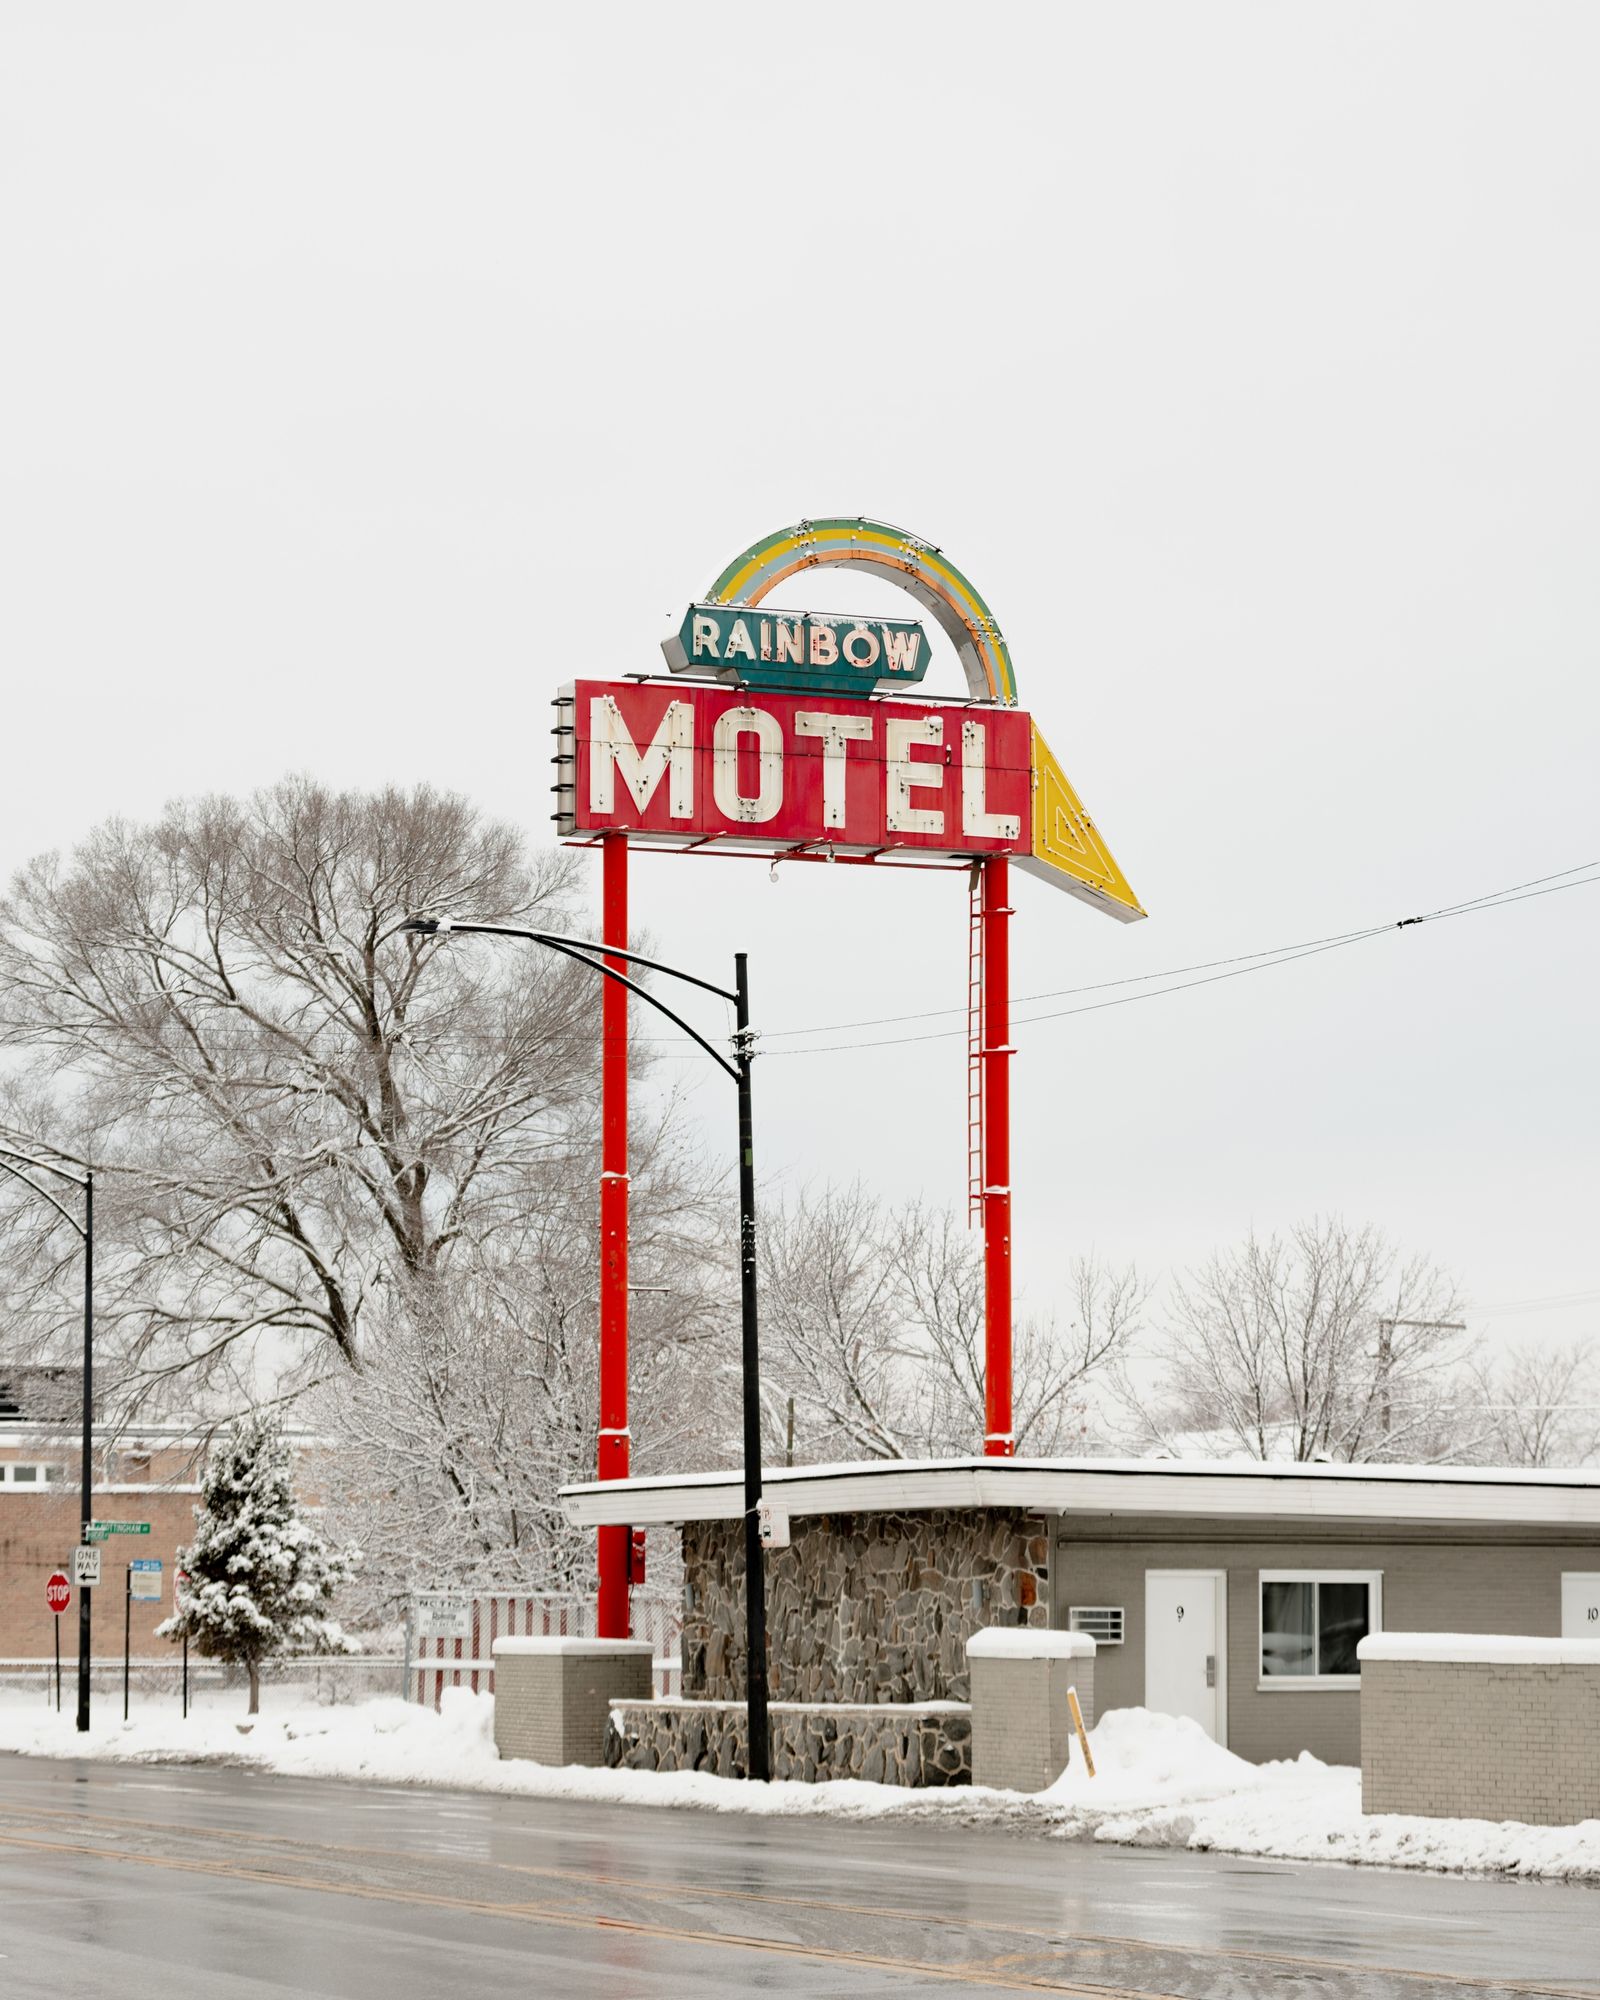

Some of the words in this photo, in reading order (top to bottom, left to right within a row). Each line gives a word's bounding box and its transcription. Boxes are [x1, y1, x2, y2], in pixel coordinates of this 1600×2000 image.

[692, 615, 921, 671] RAINBOW
[589, 694, 1021, 840] MOTEL
[78, 1551, 97, 1560] ONE
[77, 1562, 98, 1570] WAY
[47, 1585, 69, 1602] STOP
[1176, 1605, 1184, 1620] 9
[1587, 1607, 1599, 1620] 10
